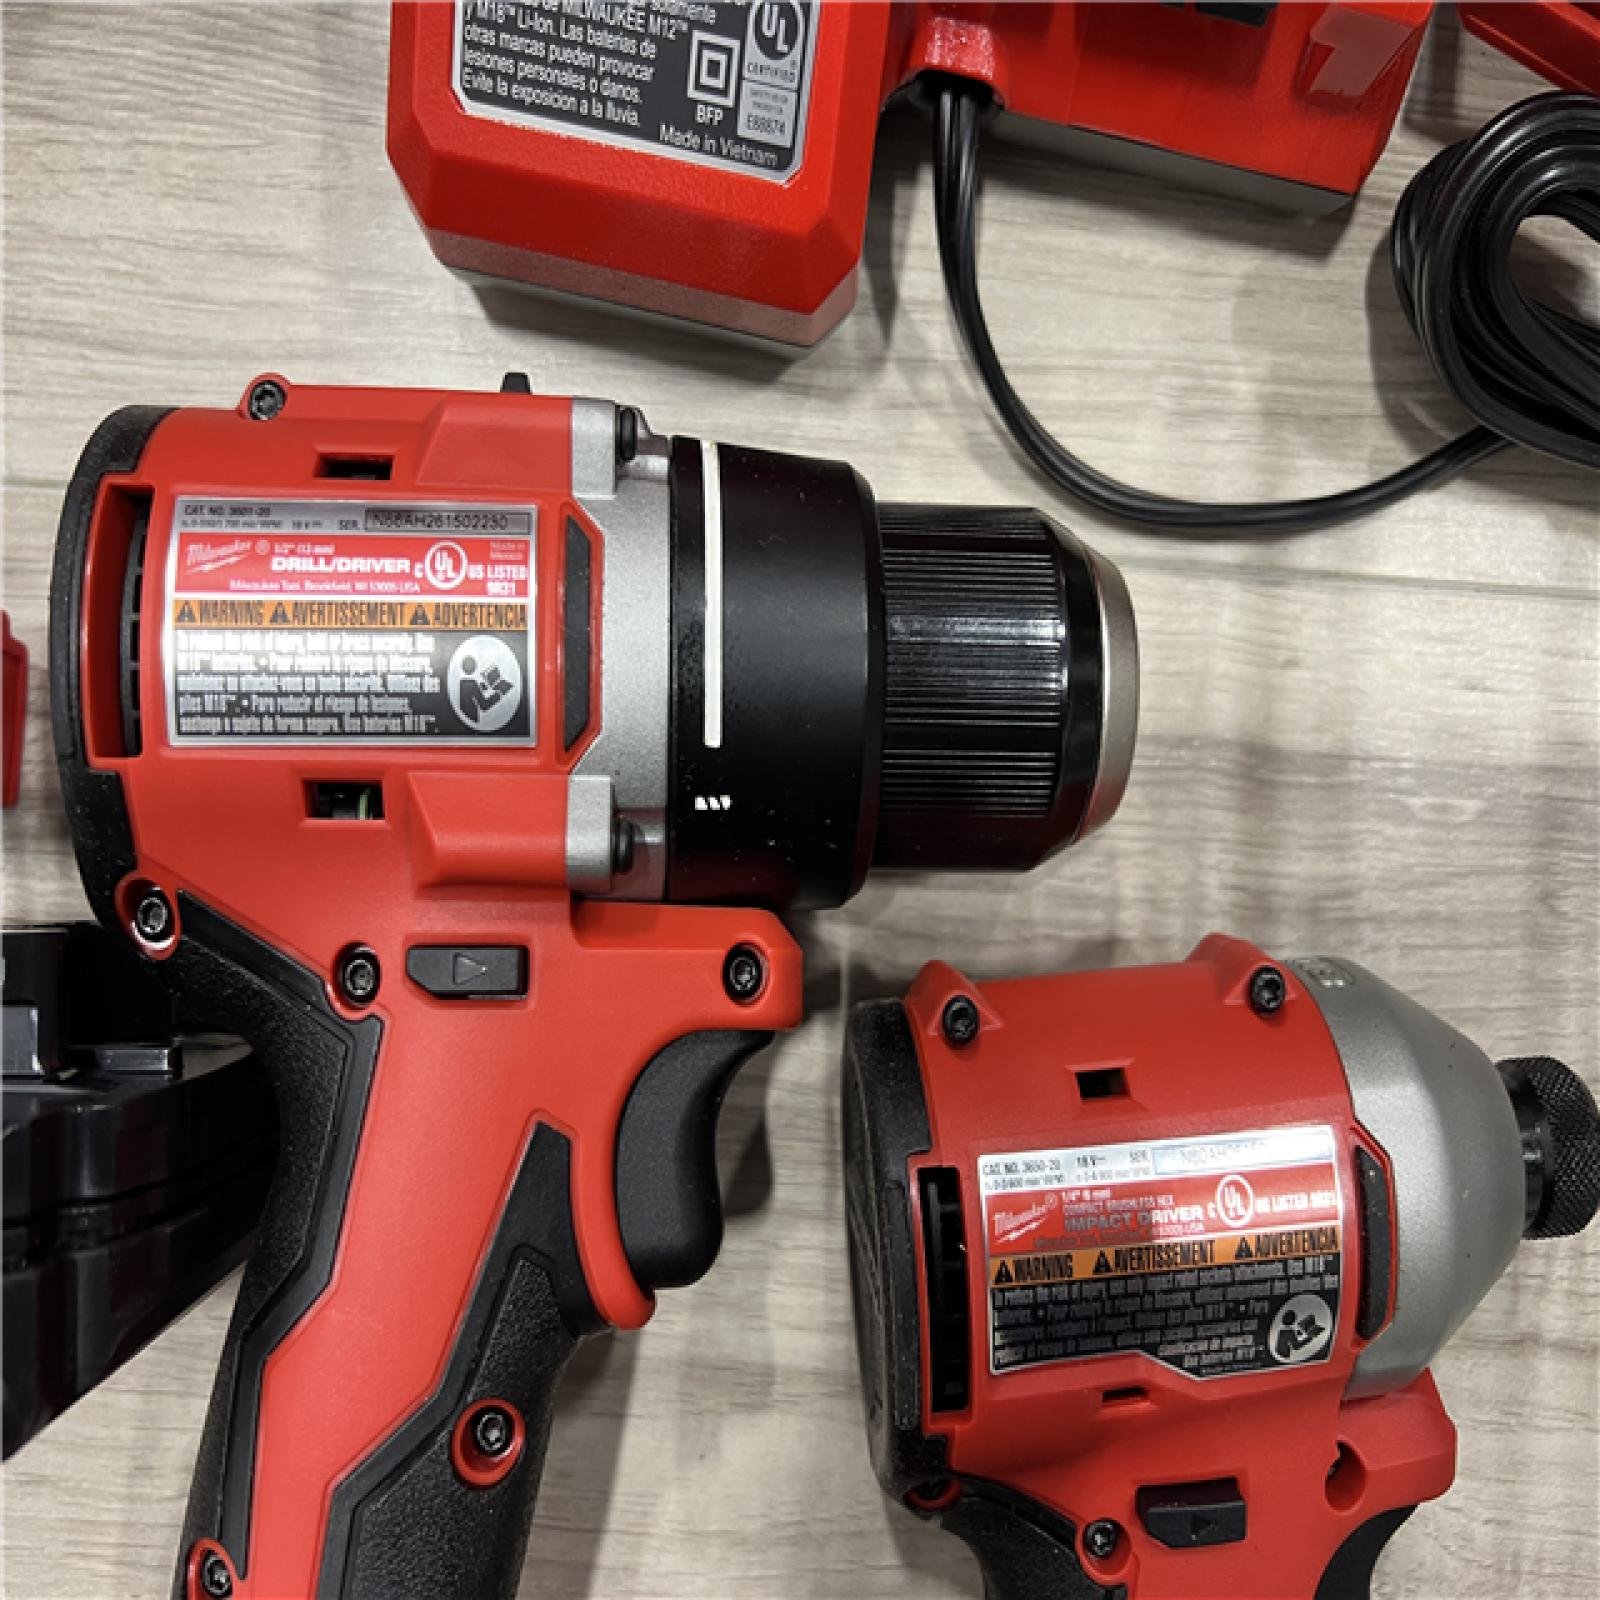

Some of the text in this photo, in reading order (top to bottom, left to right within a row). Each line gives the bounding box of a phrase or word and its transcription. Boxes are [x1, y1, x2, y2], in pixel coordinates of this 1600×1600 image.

[464, 23, 655, 82] otras marcas pueden provocar
[560, 16, 584, 43] Las
[639, 37, 656, 59] de
[464, 44, 516, 75] lesiones
[516, 61, 586, 92] personales
[463, 66, 494, 94] Evite
[496, 75, 509, 96] la
[579, 99, 589, 116] a
[591, 96, 604, 119] la
[604, 100, 641, 128] lluvia.
[695, 103, 724, 126] BFP
[659, 122, 779, 167] Made in Vietnam
[270, 556, 411, 574] DRILL/DRIVER
[433, 551, 456, 579] UL
[486, 563, 529, 582] LISTED
[199, 600, 528, 629] WARNING AVERTISSEMENT ADVERTENCIA
[1064, 1204, 1204, 1233] IMPACT DRIVER
[1272, 1194, 1309, 1211] LISTED
[1013, 1225, 1339, 1282] WARNING AVERTISSEMENT ADVERTENCIA
